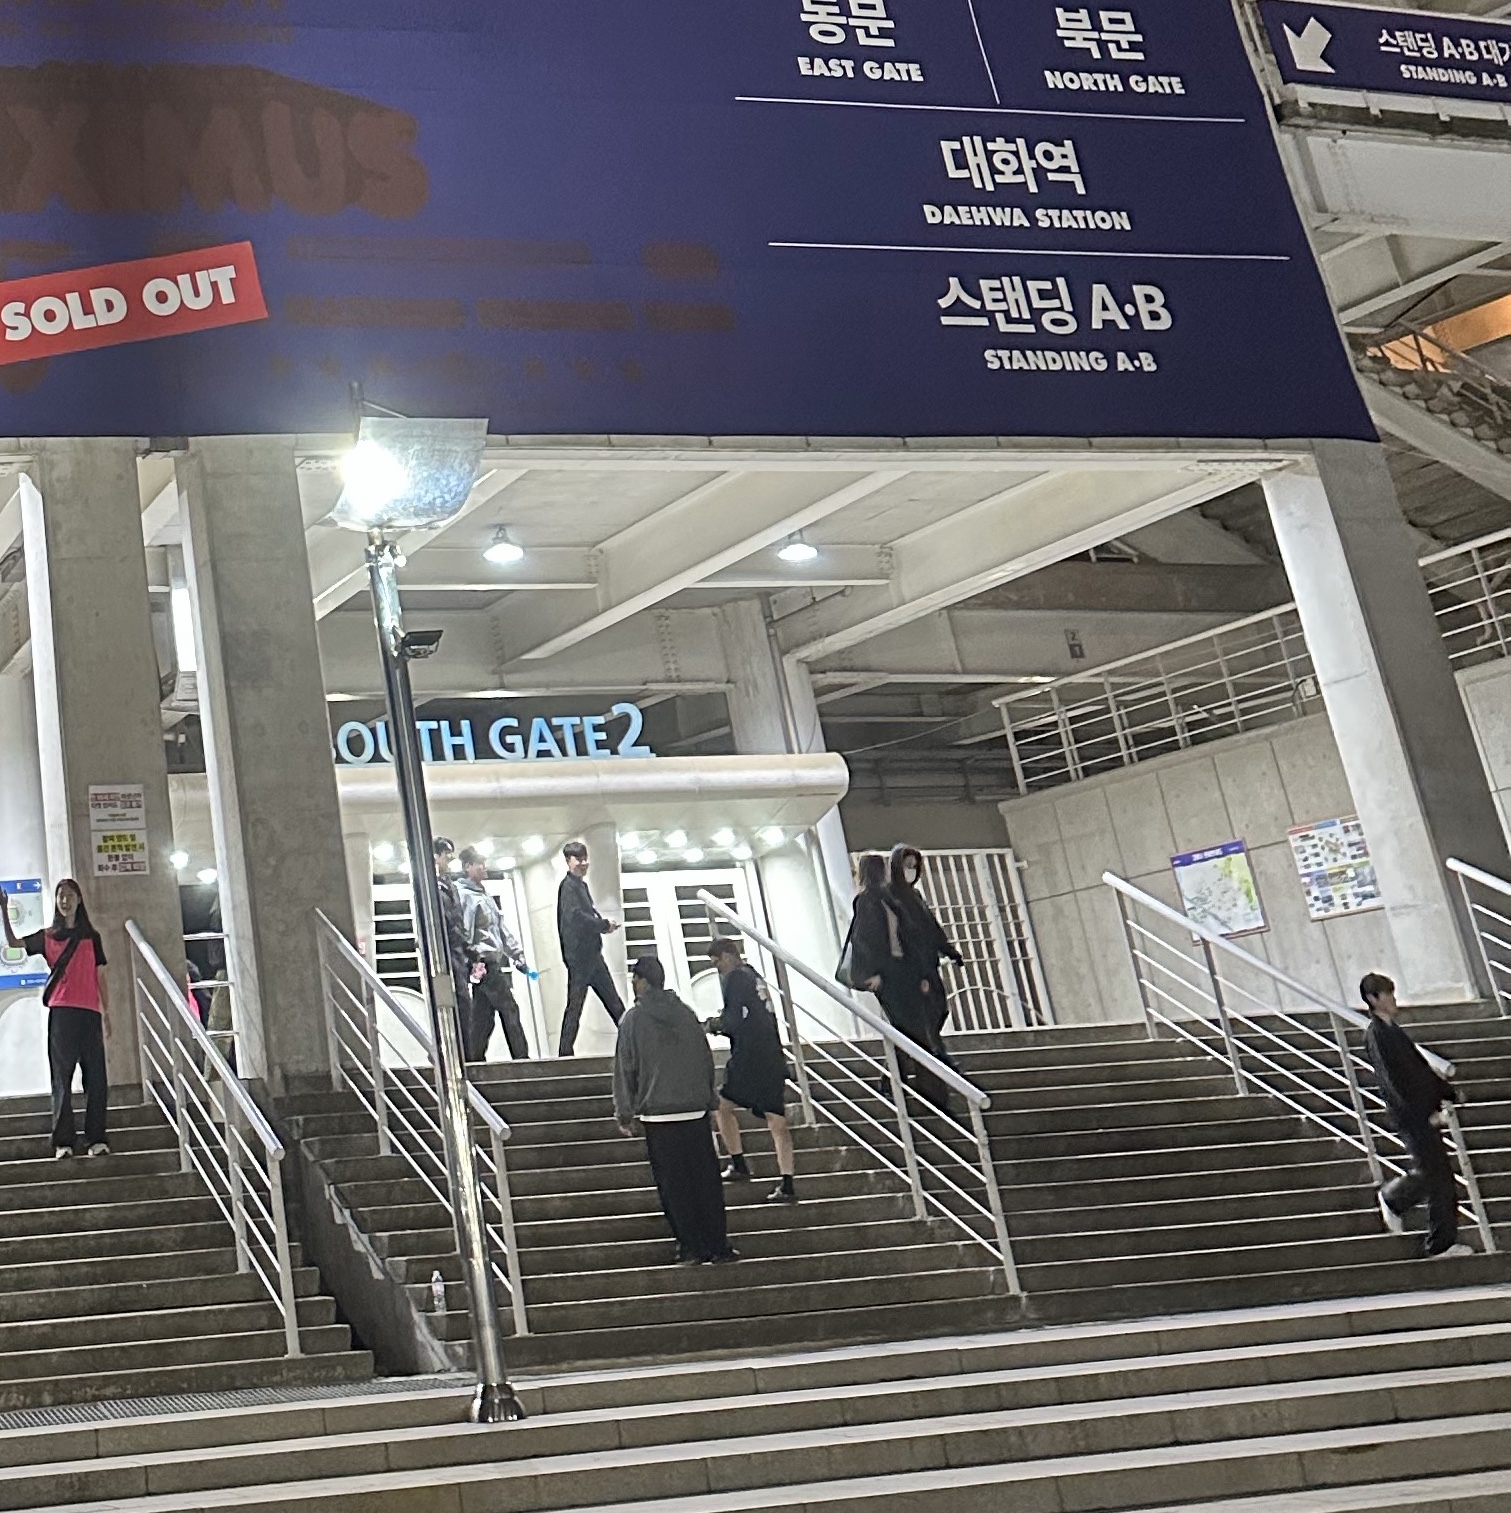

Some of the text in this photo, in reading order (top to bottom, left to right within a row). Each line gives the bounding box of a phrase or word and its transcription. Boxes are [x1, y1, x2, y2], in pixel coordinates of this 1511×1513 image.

[1055, 6, 1145, 62] 북문
[1378, 28, 1439, 60] 스탠딩
[797, 56, 925, 83] EAST GATE
[1043, 69, 1186, 96] NORTH GATE
[1399, 64, 1479, 86] STANDING
[939, 135, 1086, 196] 대화역
[922, 203, 1133, 232] DAEHWA STATION
[0, 286, 129, 342] SOLD
[141, 264, 237, 317] OUT
[937, 276, 1079, 336] 스탠딩
[983, 348, 1108, 373] STANDING
